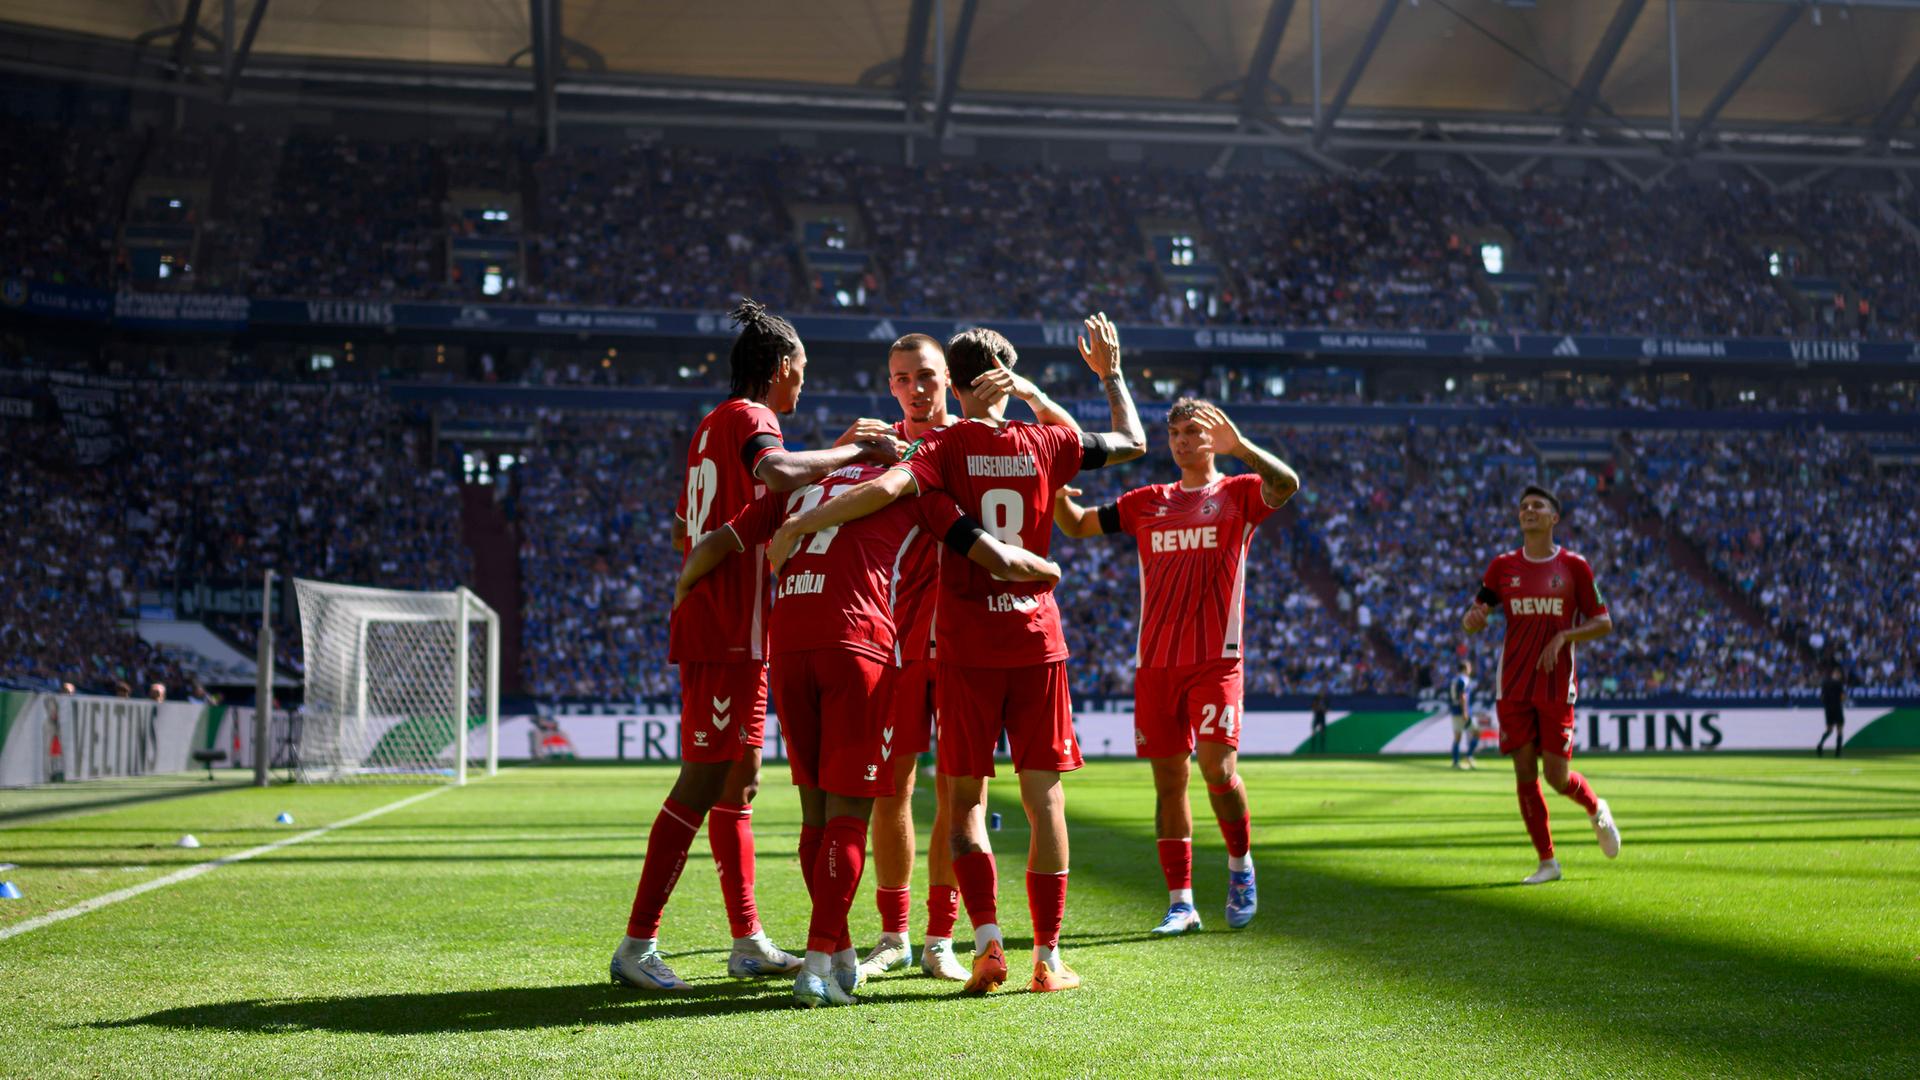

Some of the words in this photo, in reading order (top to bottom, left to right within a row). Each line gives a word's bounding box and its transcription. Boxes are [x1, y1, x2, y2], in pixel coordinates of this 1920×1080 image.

[306, 301, 394, 325] VELTINS
[1790, 340, 1860, 364] VELTINS
[981, 488, 1025, 582] 8
[1151, 526, 1219, 553] REWE
[794, 570, 826, 595] KÖLN
[986, 595, 998, 612] 1.
[997, 593, 1012, 612] FC
[1510, 598, 1564, 616] REWE
[1199, 703, 1237, 738] 24
[72, 700, 158, 778] VELTINS
